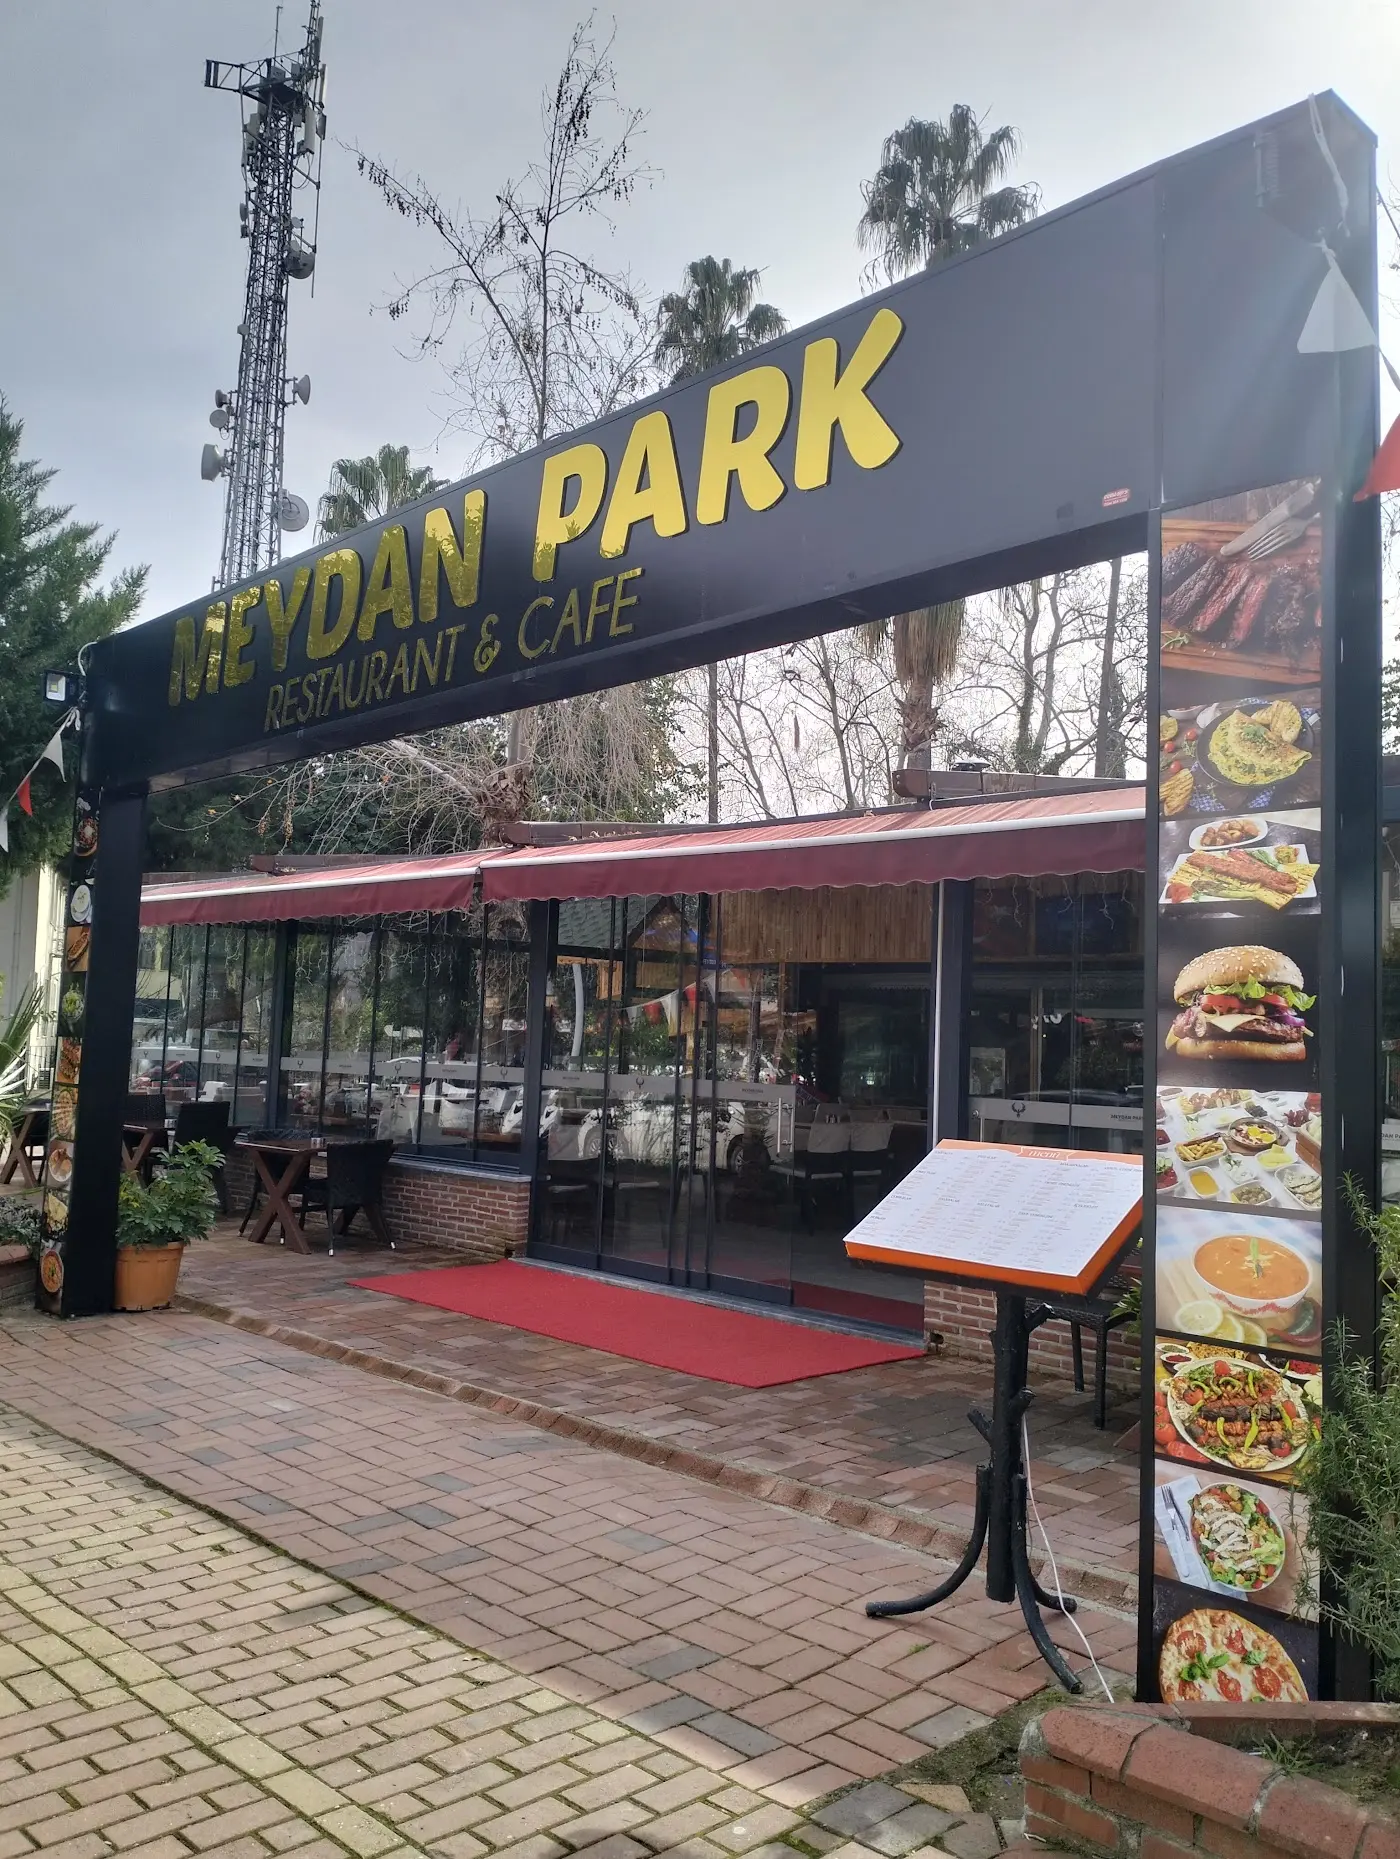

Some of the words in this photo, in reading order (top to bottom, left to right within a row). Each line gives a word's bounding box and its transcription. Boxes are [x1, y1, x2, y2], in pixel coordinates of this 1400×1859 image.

[168, 487, 487, 707] MEYDAN
[532, 308, 905, 582] PARK
[263, 623, 467, 733] RESTAURANT
[473, 613, 502, 673] &
[517, 567, 645, 660] CAFE
